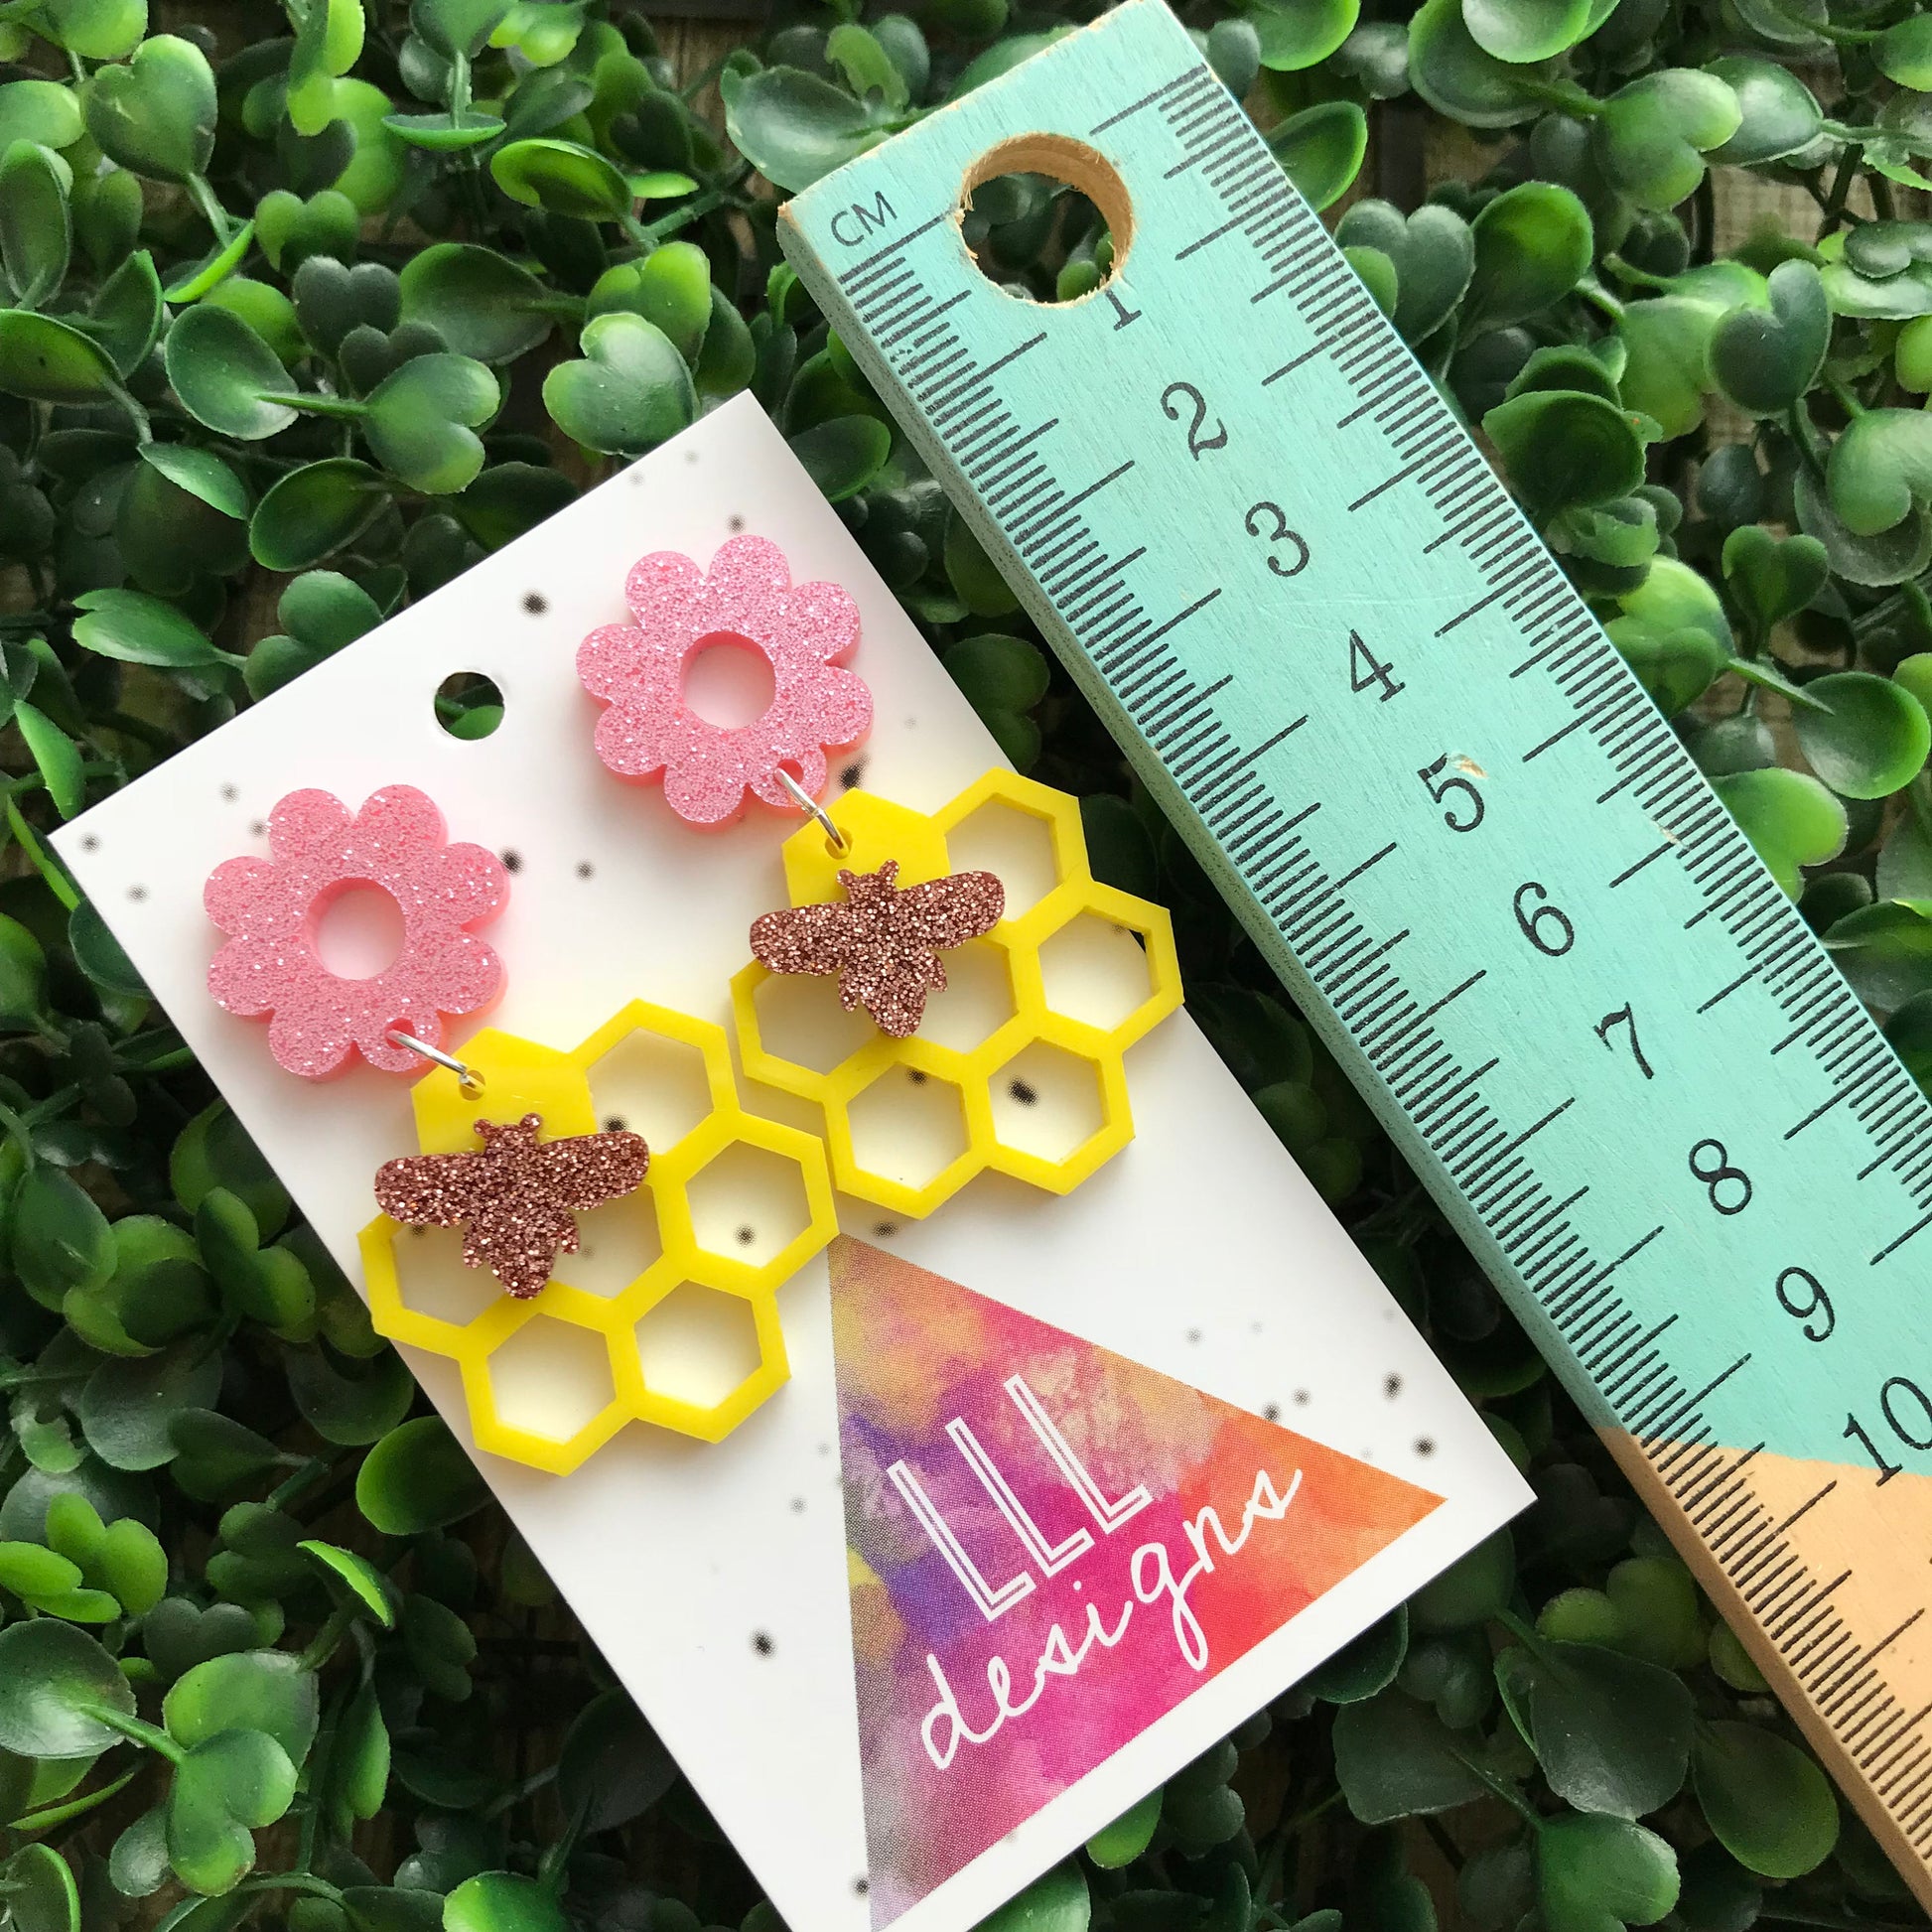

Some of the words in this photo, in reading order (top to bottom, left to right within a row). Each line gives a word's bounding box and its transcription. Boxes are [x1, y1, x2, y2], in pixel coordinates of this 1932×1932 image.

[830, 190, 898, 248] CM
[1104, 284, 1142, 331] 1
[1159, 381, 1229, 461] 2
[1245, 501, 1311, 577] 3
[1348, 628, 1406, 702] 4
[1417, 752, 1486, 833] 5
[1513, 881, 1575, 957] 6
[1593, 1002, 1654, 1079] 7
[1689, 1138, 1752, 1215] 8
[1775, 1266, 1836, 1342] 9
[1843, 1375, 1932, 1487] 10
[887, 1373, 1153, 1622] LLL
[921, 1468, 1302, 1770] designs
